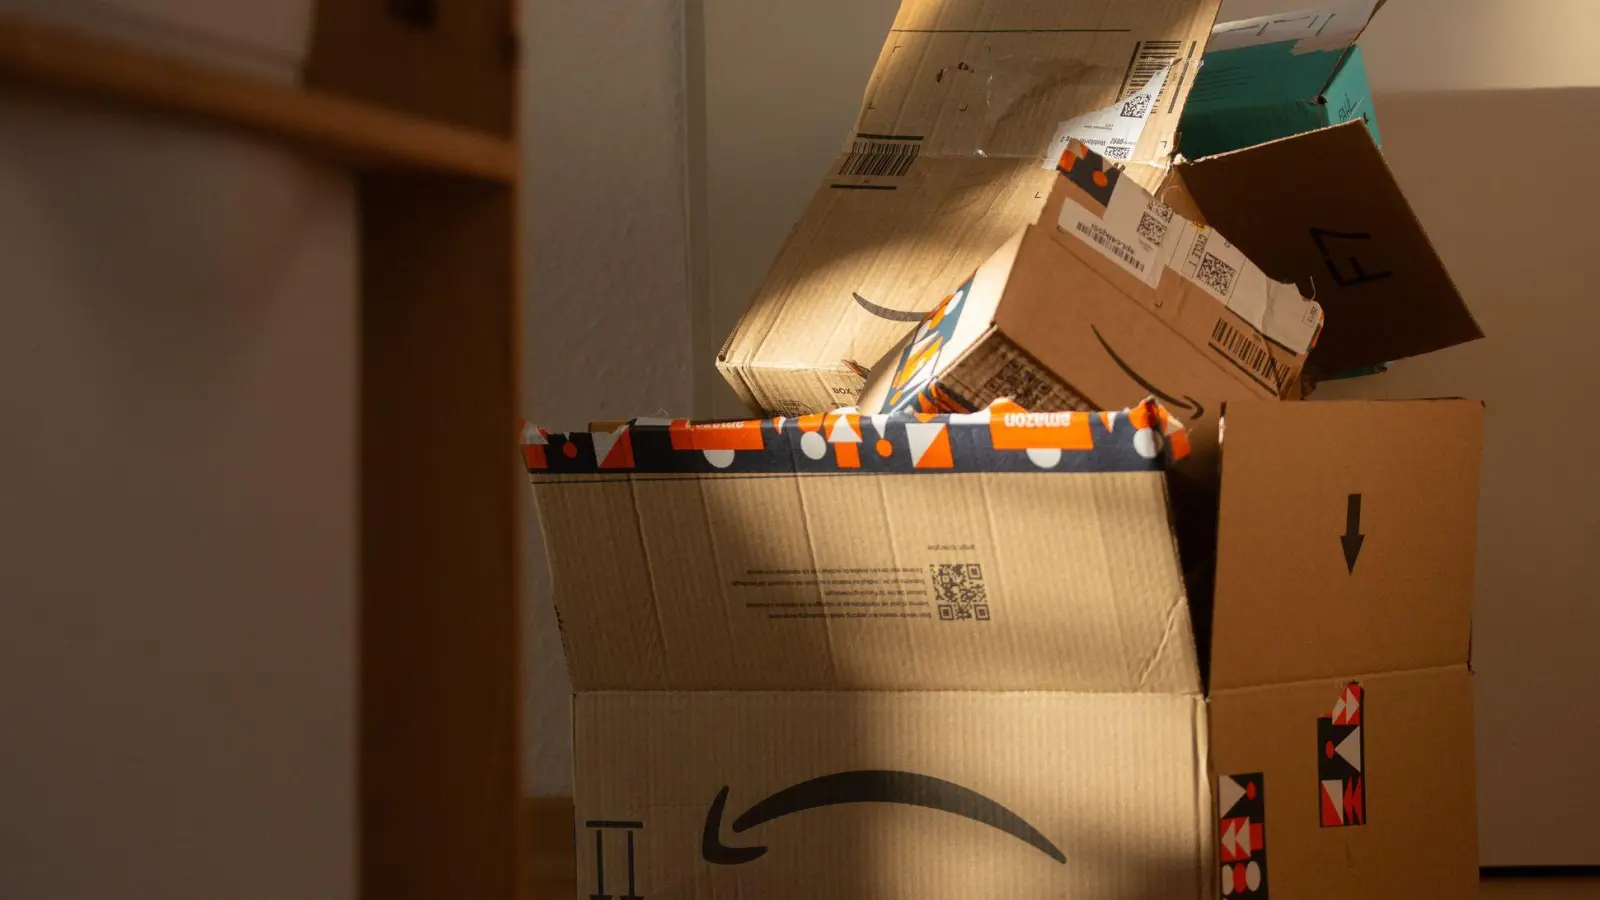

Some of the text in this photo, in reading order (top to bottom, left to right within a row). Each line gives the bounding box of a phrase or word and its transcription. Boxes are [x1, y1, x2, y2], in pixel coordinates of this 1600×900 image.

[1191, 234, 1208, 261] CYCLE
[1309, 226, 1392, 287] F7
[832, 387, 853, 395] BOX
[1004, 411, 1071, 428] amazon
